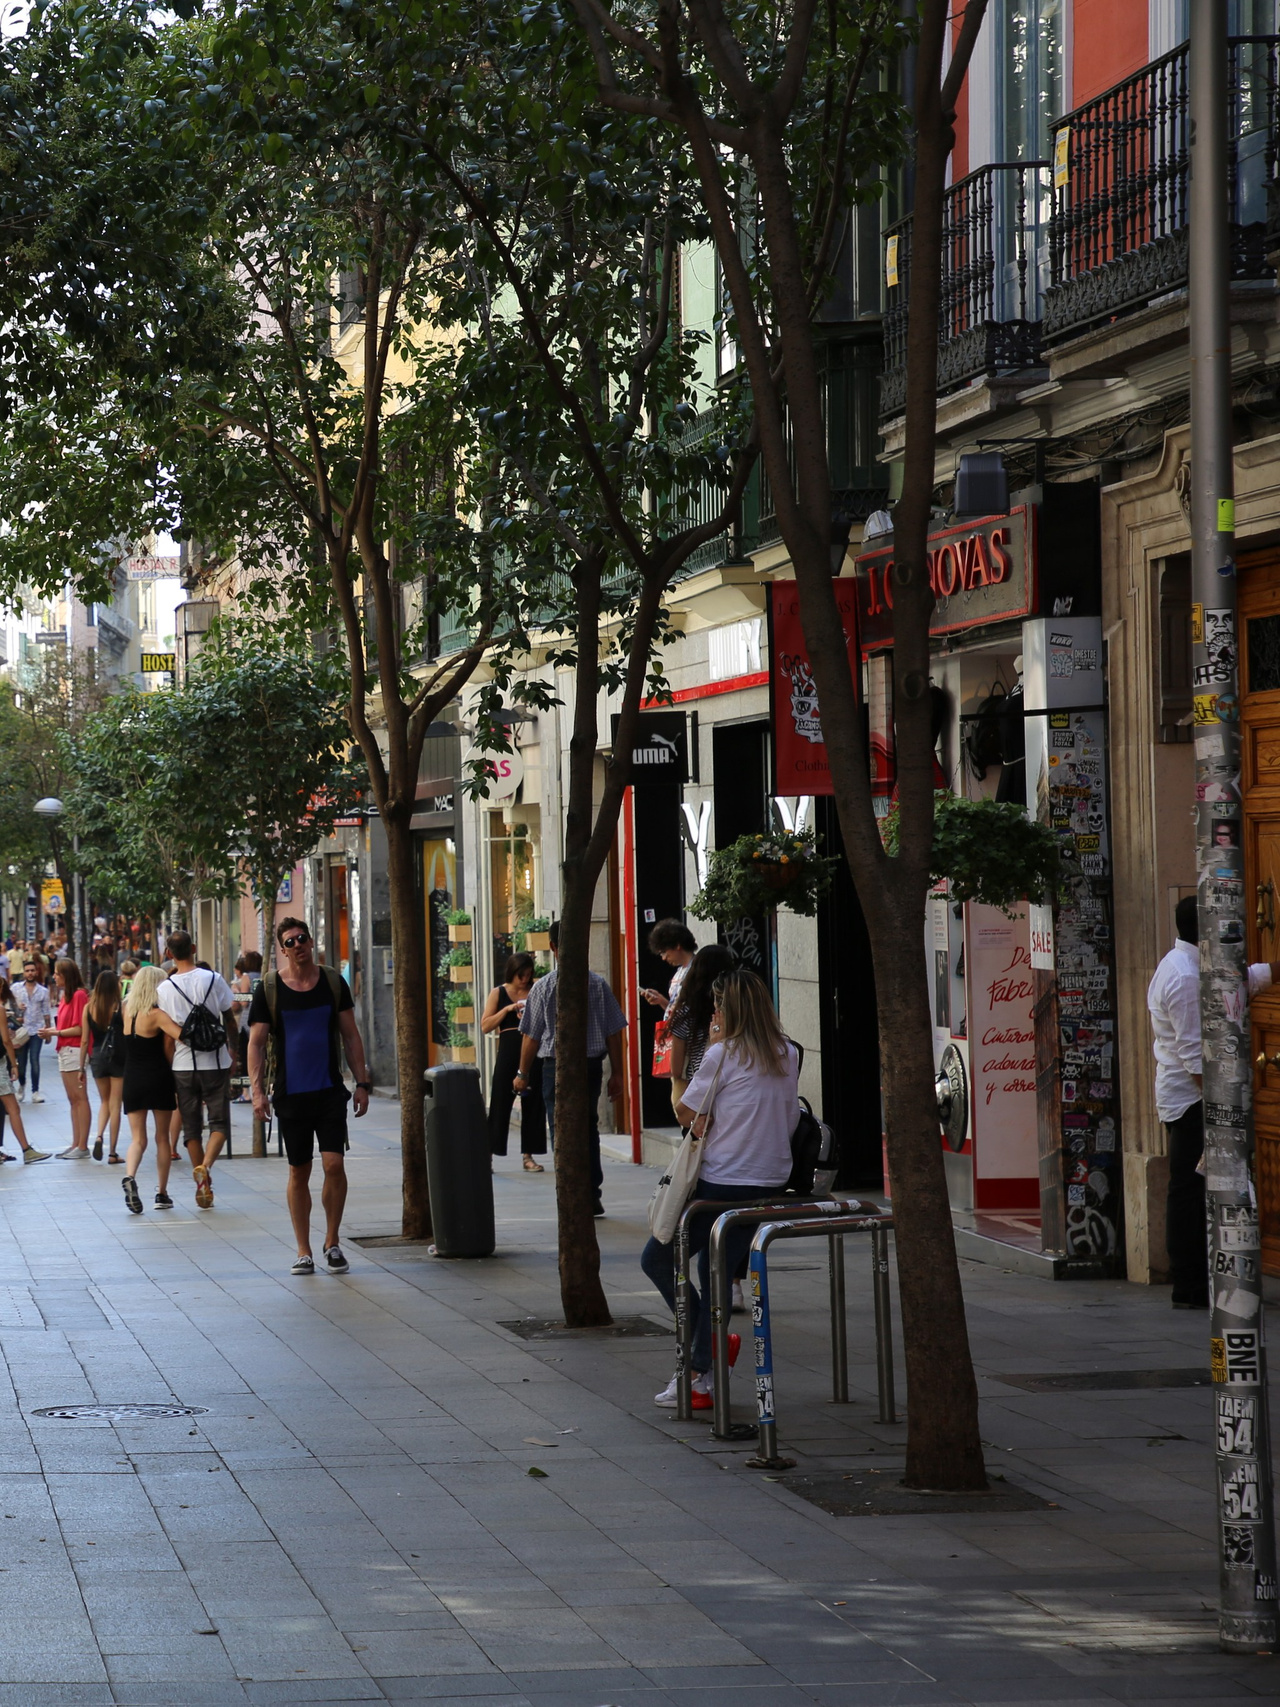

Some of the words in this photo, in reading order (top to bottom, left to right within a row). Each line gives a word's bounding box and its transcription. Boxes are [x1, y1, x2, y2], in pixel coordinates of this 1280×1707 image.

[867, 567, 884, 616] J.
[142, 654, 174, 671] HOST
[632, 747, 675, 765] UMA
[1032, 931, 1052, 953] SALE
[1088, 1001, 1109, 1010] 1992
[1227, 1333, 1258, 1382] BNE
[1220, 1397, 1254, 1419] TAEM
[1219, 1416, 1254, 1455] 54
[1224, 1484, 1259, 1519] 54
